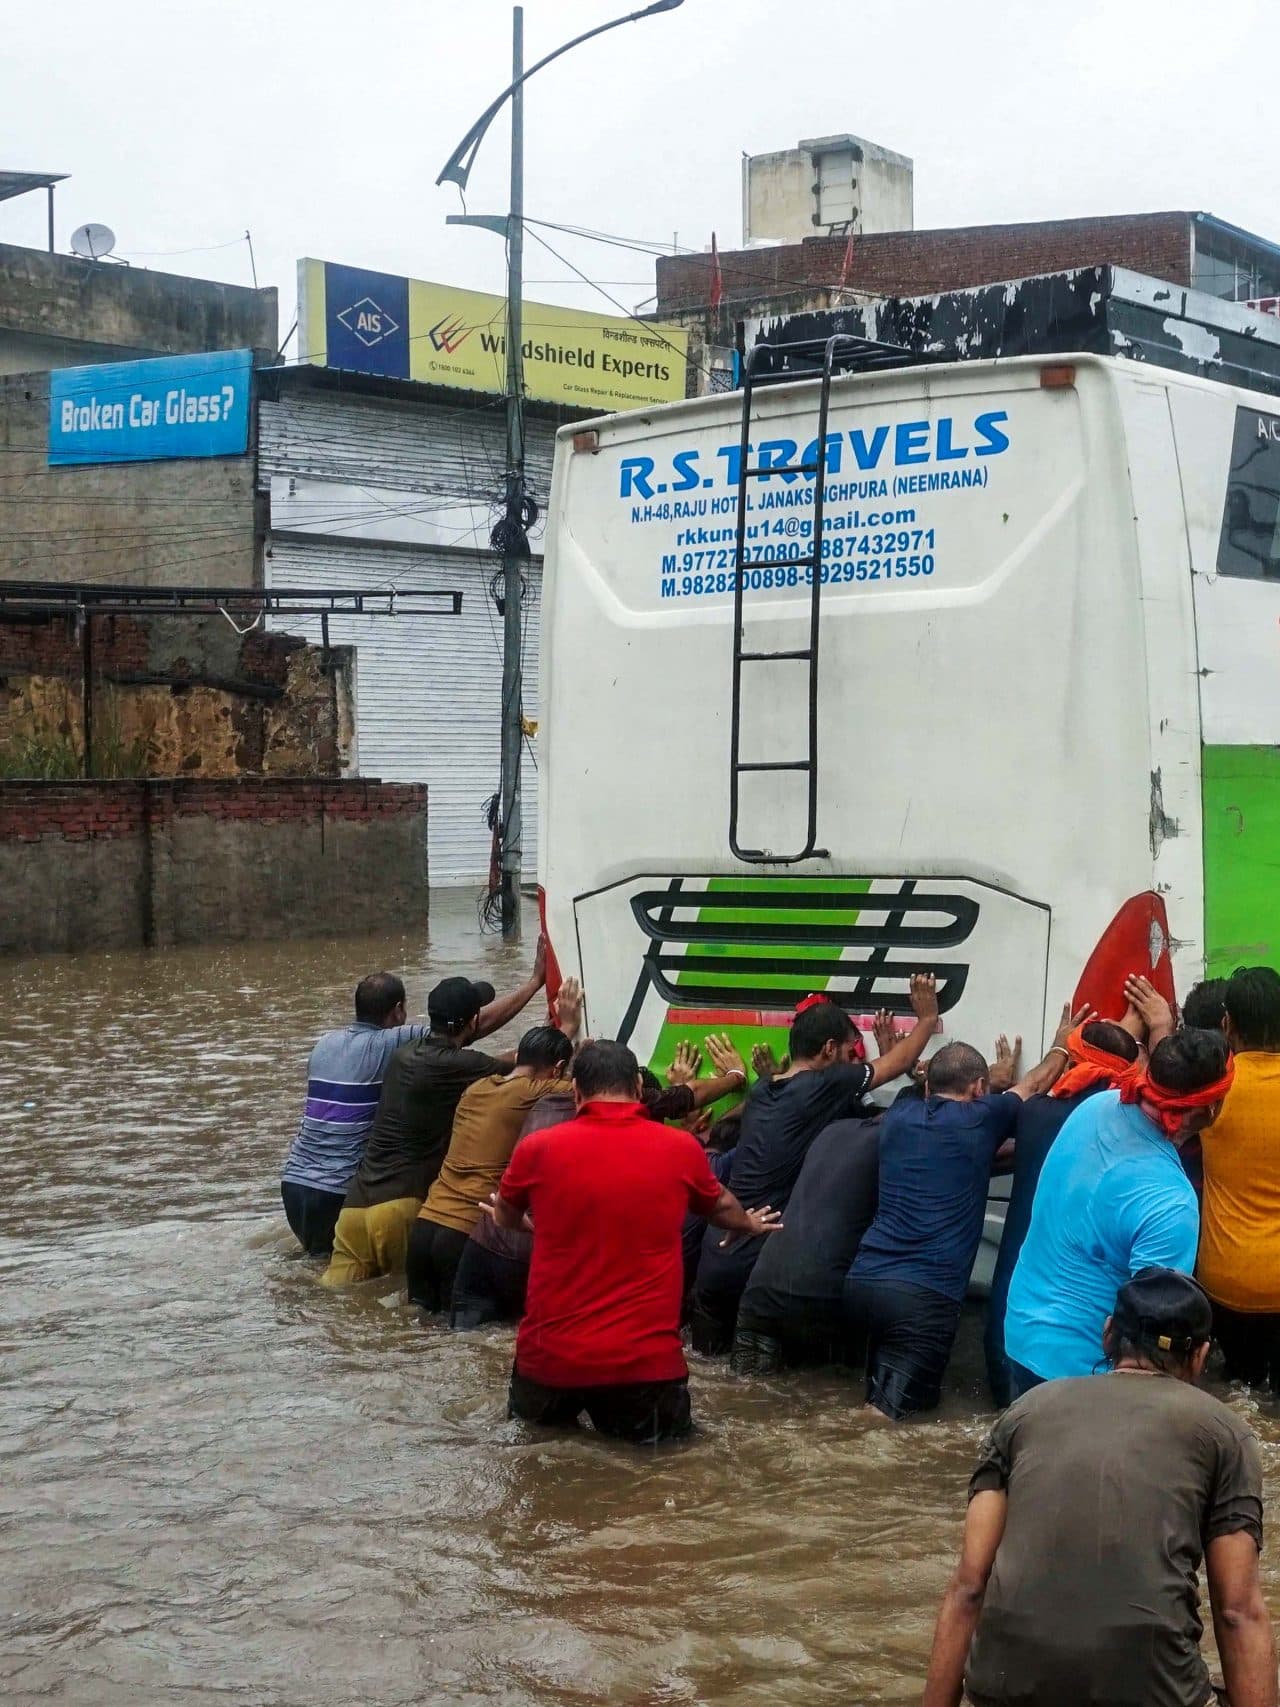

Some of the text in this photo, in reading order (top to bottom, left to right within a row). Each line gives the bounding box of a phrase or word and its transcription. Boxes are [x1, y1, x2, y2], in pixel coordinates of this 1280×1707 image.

[357, 312, 381, 333] AIS
[480, 333, 670, 381] Widshield Experts
[61, 386, 235, 434] Broken Car Glass?
[563, 383, 573, 391] Car
[574, 384, 589, 393] Glass
[590, 387, 608, 397] Repair
[614, 390, 649, 402] Replacement
[1257, 417, 1280, 442] A/C
[620, 411, 1011, 501] R.S.TRAVELS
[631, 499, 707, 523] N.H-48,RAJU
[711, 494, 755, 515] HOTL
[893, 465, 988, 498] (NEEMRANA)
[677, 508, 916, 546] rkkunu14@gmail.com
